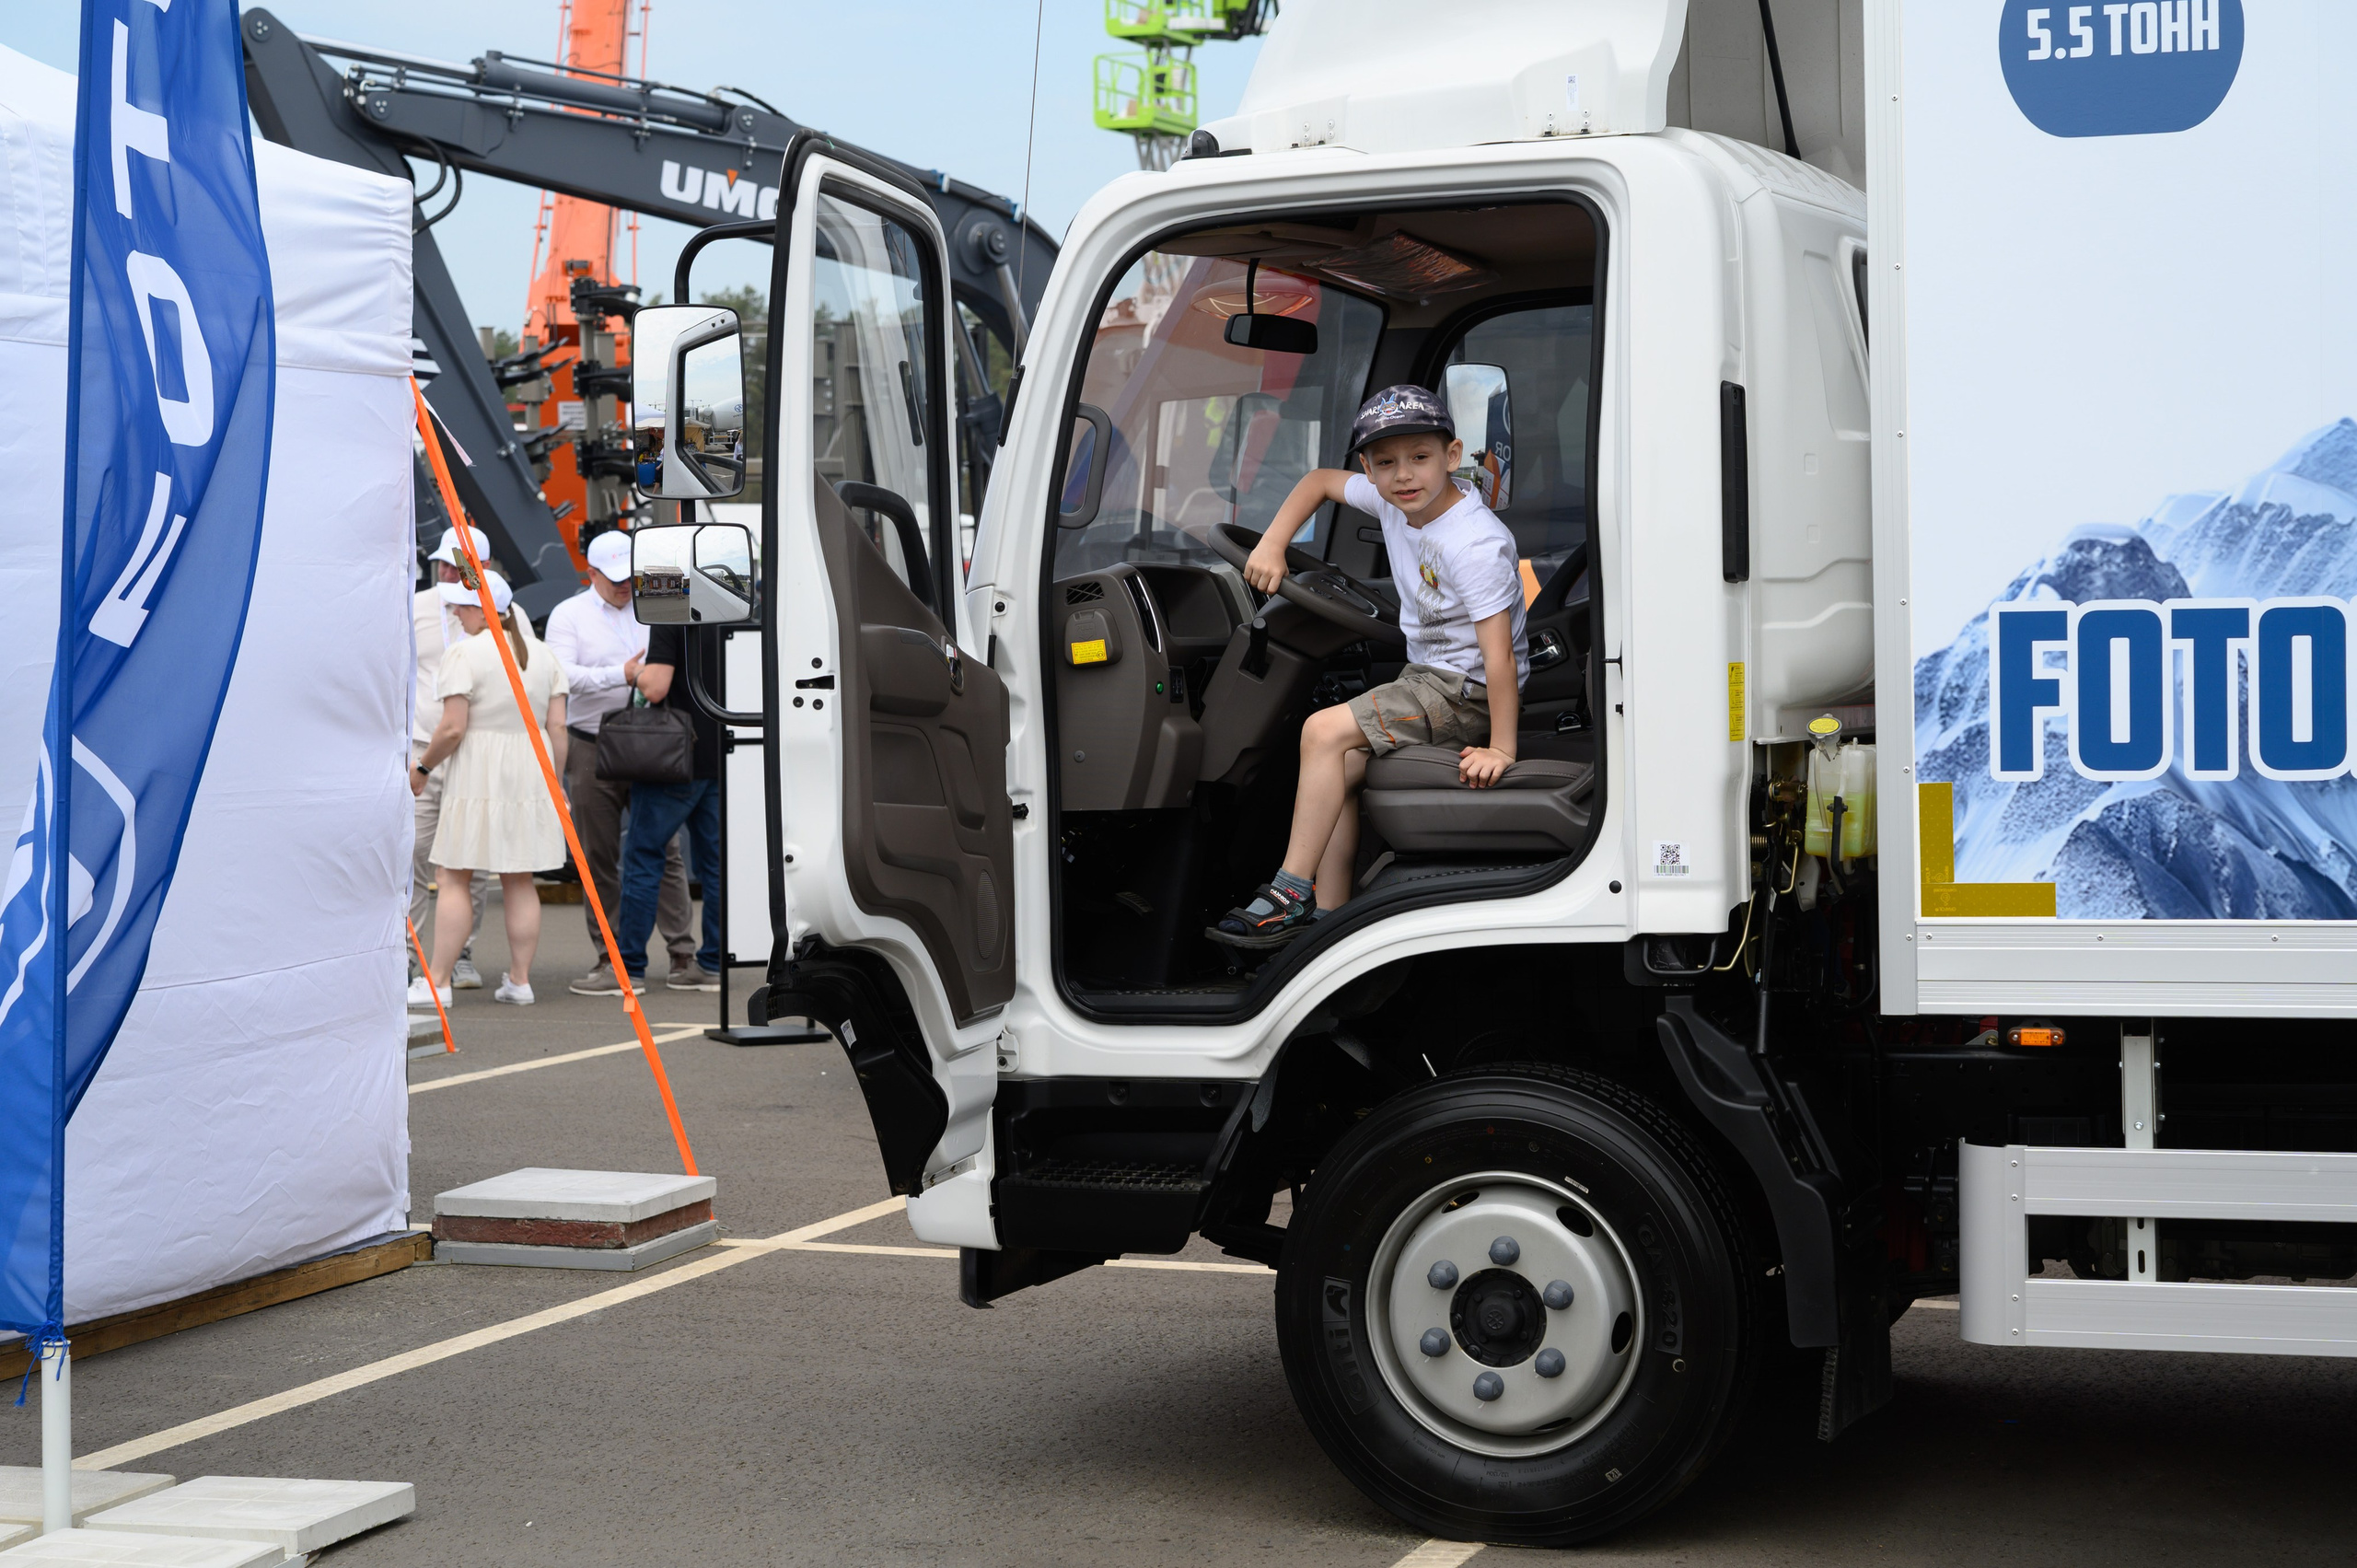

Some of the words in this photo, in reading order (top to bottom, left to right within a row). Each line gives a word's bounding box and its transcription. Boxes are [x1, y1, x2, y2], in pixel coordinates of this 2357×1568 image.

[2027, 6, 2094, 61] 5.5
[2103, 0, 2220, 56] ТОНН
[89, 0, 215, 648] FOT
[1399, 401, 1425, 411] AREA
[1994, 600, 2357, 776] FOTO
